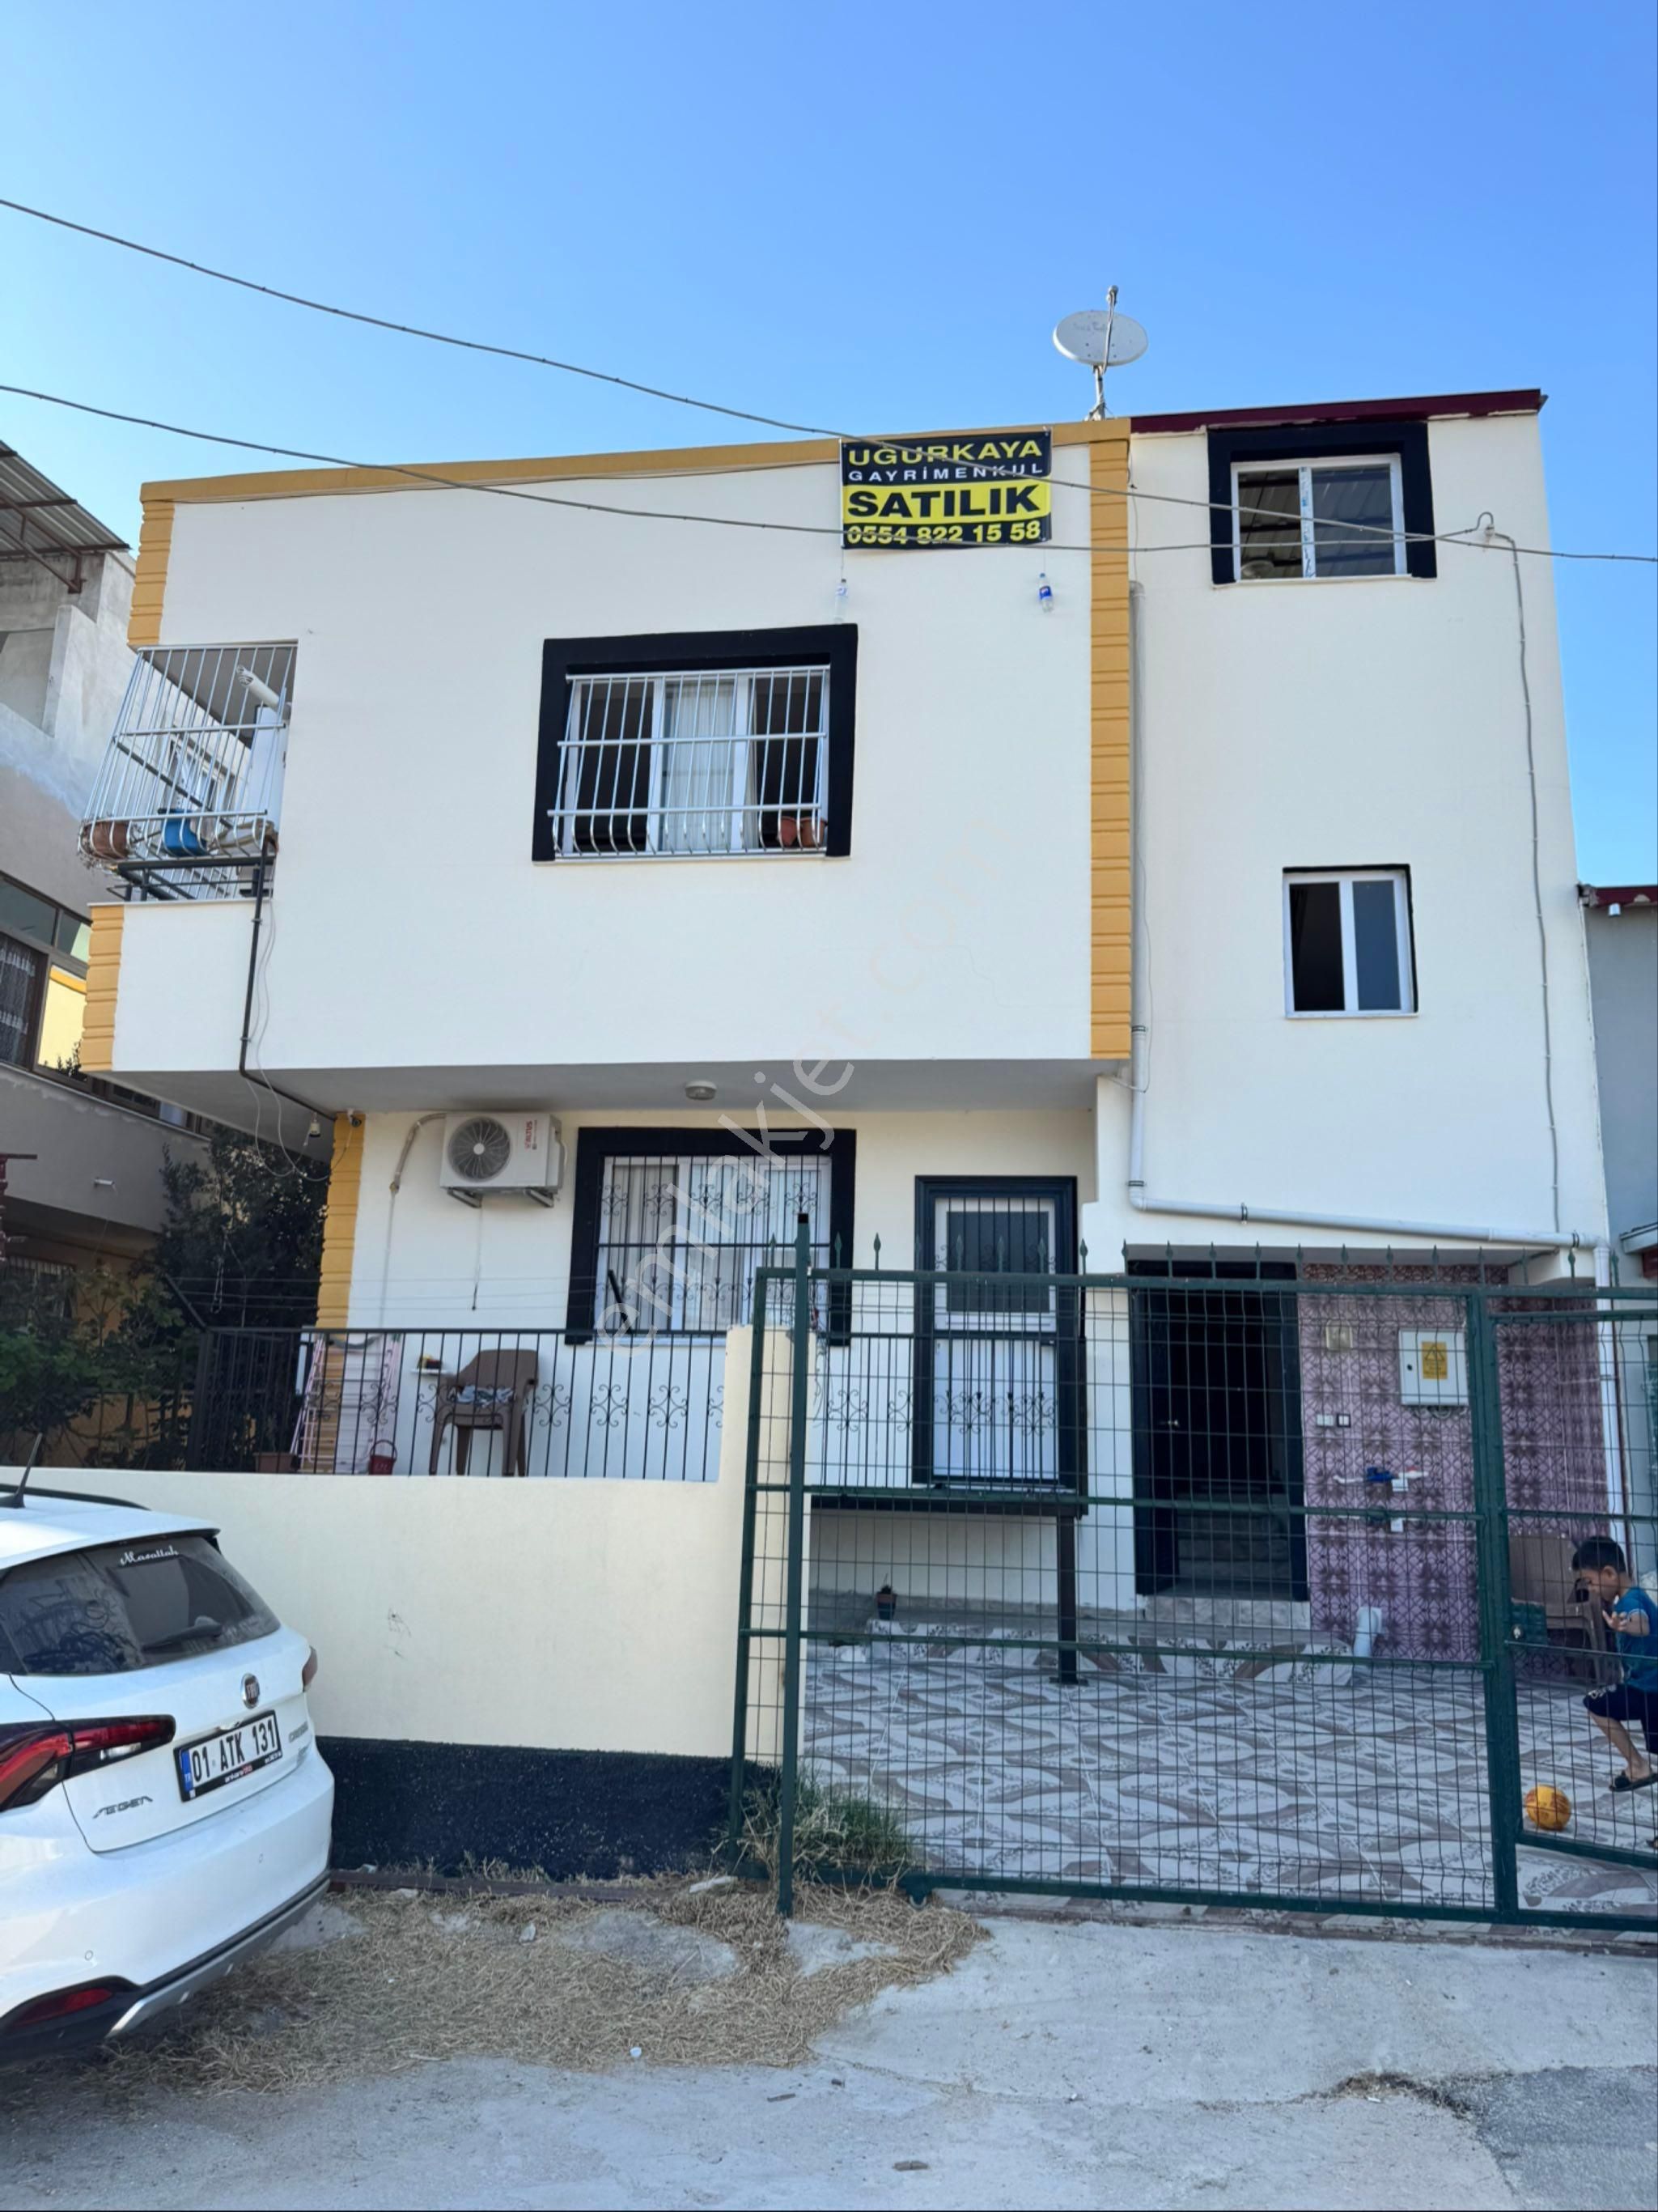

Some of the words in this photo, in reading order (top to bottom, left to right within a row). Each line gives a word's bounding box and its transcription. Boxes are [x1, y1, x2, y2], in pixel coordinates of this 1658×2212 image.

[848, 463, 1043, 482] GAYRİMENKUL
[848, 484, 1041, 519] SATILIK
[847, 525, 907, 545] 0554
[917, 525, 963, 545] 822
[973, 524, 1002, 542] 15
[1009, 520, 1041, 541] 58
[192, 1746, 210, 1782] 01
[219, 1731, 245, 1772] ATK
[252, 1718, 276, 1756] 131
